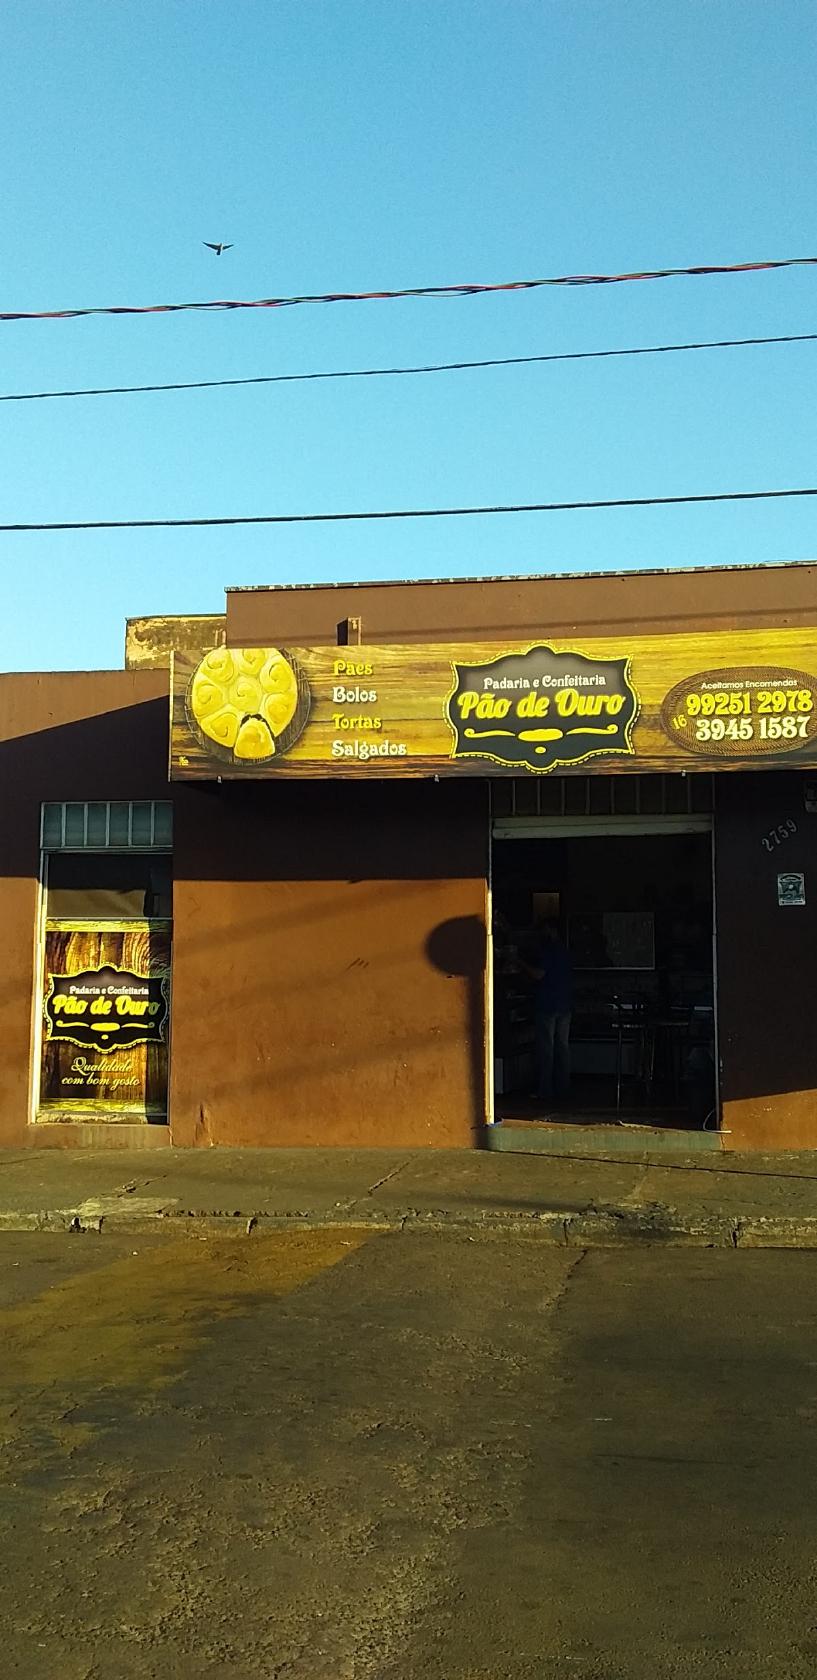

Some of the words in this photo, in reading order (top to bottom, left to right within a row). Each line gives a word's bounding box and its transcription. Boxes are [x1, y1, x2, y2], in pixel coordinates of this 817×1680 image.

[483, 677, 530, 689] Padaria
[533, 679, 540, 688] e
[542, 674, 607, 688] Confeitaria
[701, 681, 744, 690] Aceitamos
[745, 679, 798, 688] Encomendas
[332, 686, 377, 703] Bolos
[457, 691, 513, 719] Pão
[516, 691, 550, 718] de
[554, 688, 627, 717] Ouro
[686, 692, 752, 716] 99251
[757, 689, 814, 714] 2978
[332, 713, 382, 729] Tortas
[671, 714, 688, 730] 16
[695, 717, 754, 741] 3945
[759, 715, 811, 739] 1587
[331, 739, 407, 760] Salgados
[761, 818, 798, 852] 2759
[69, 986, 100, 995] Padaria
[107, 986, 149, 995] Confeitaria
[52, 994, 89, 1015] Pão
[90, 995, 113, 1015] de
[115, 995, 161, 1016] Ouro
[70, 1056, 134, 1076] Qualidade
[61, 1076, 84, 1085] com
[86, 1071, 110, 1085] bom
[110, 1075, 140, 1091] gosto
